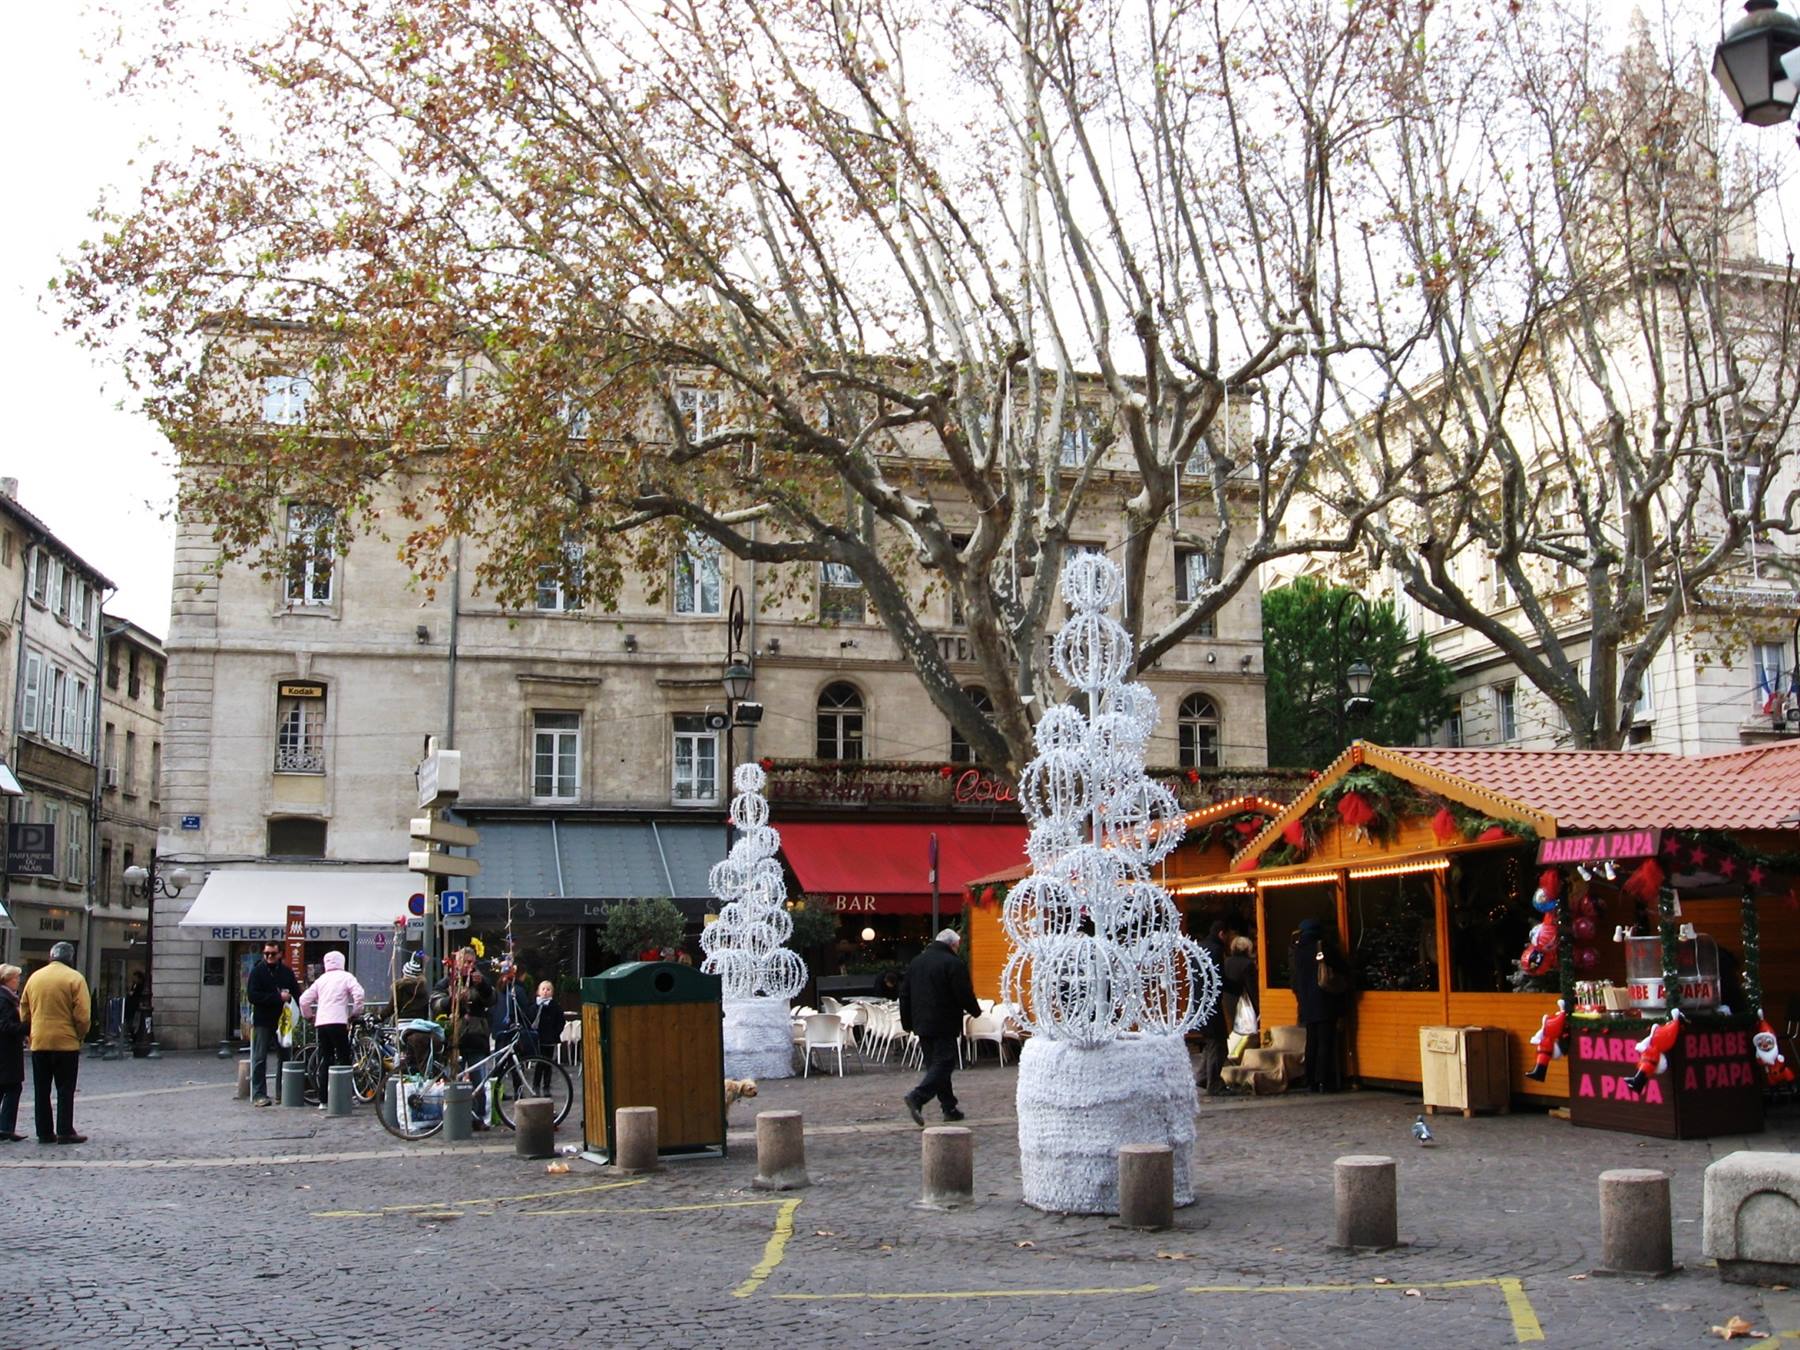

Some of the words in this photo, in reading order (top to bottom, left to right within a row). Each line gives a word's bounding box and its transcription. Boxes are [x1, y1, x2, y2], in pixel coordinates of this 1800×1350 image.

[288, 687, 314, 696] Kodak
[955, 769, 1017, 803] Cou
[1542, 837, 1595, 864] BARBE
[1595, 837, 1606, 859] A
[1609, 831, 1654, 857] PAPA
[18, 864, 43, 872] PALAIS
[448, 895, 459, 912] P
[836, 895, 877, 911] BAR
[212, 927, 267, 940] REFLEX
[271, 927, 320, 940] PHTO
[1578, 1036, 1640, 1064] BARB
[1684, 1031, 1747, 1059] BARBE
[1578, 1074, 1595, 1099] A
[1684, 1066, 1698, 1090] A
[1706, 1062, 1754, 1088] PAPA
